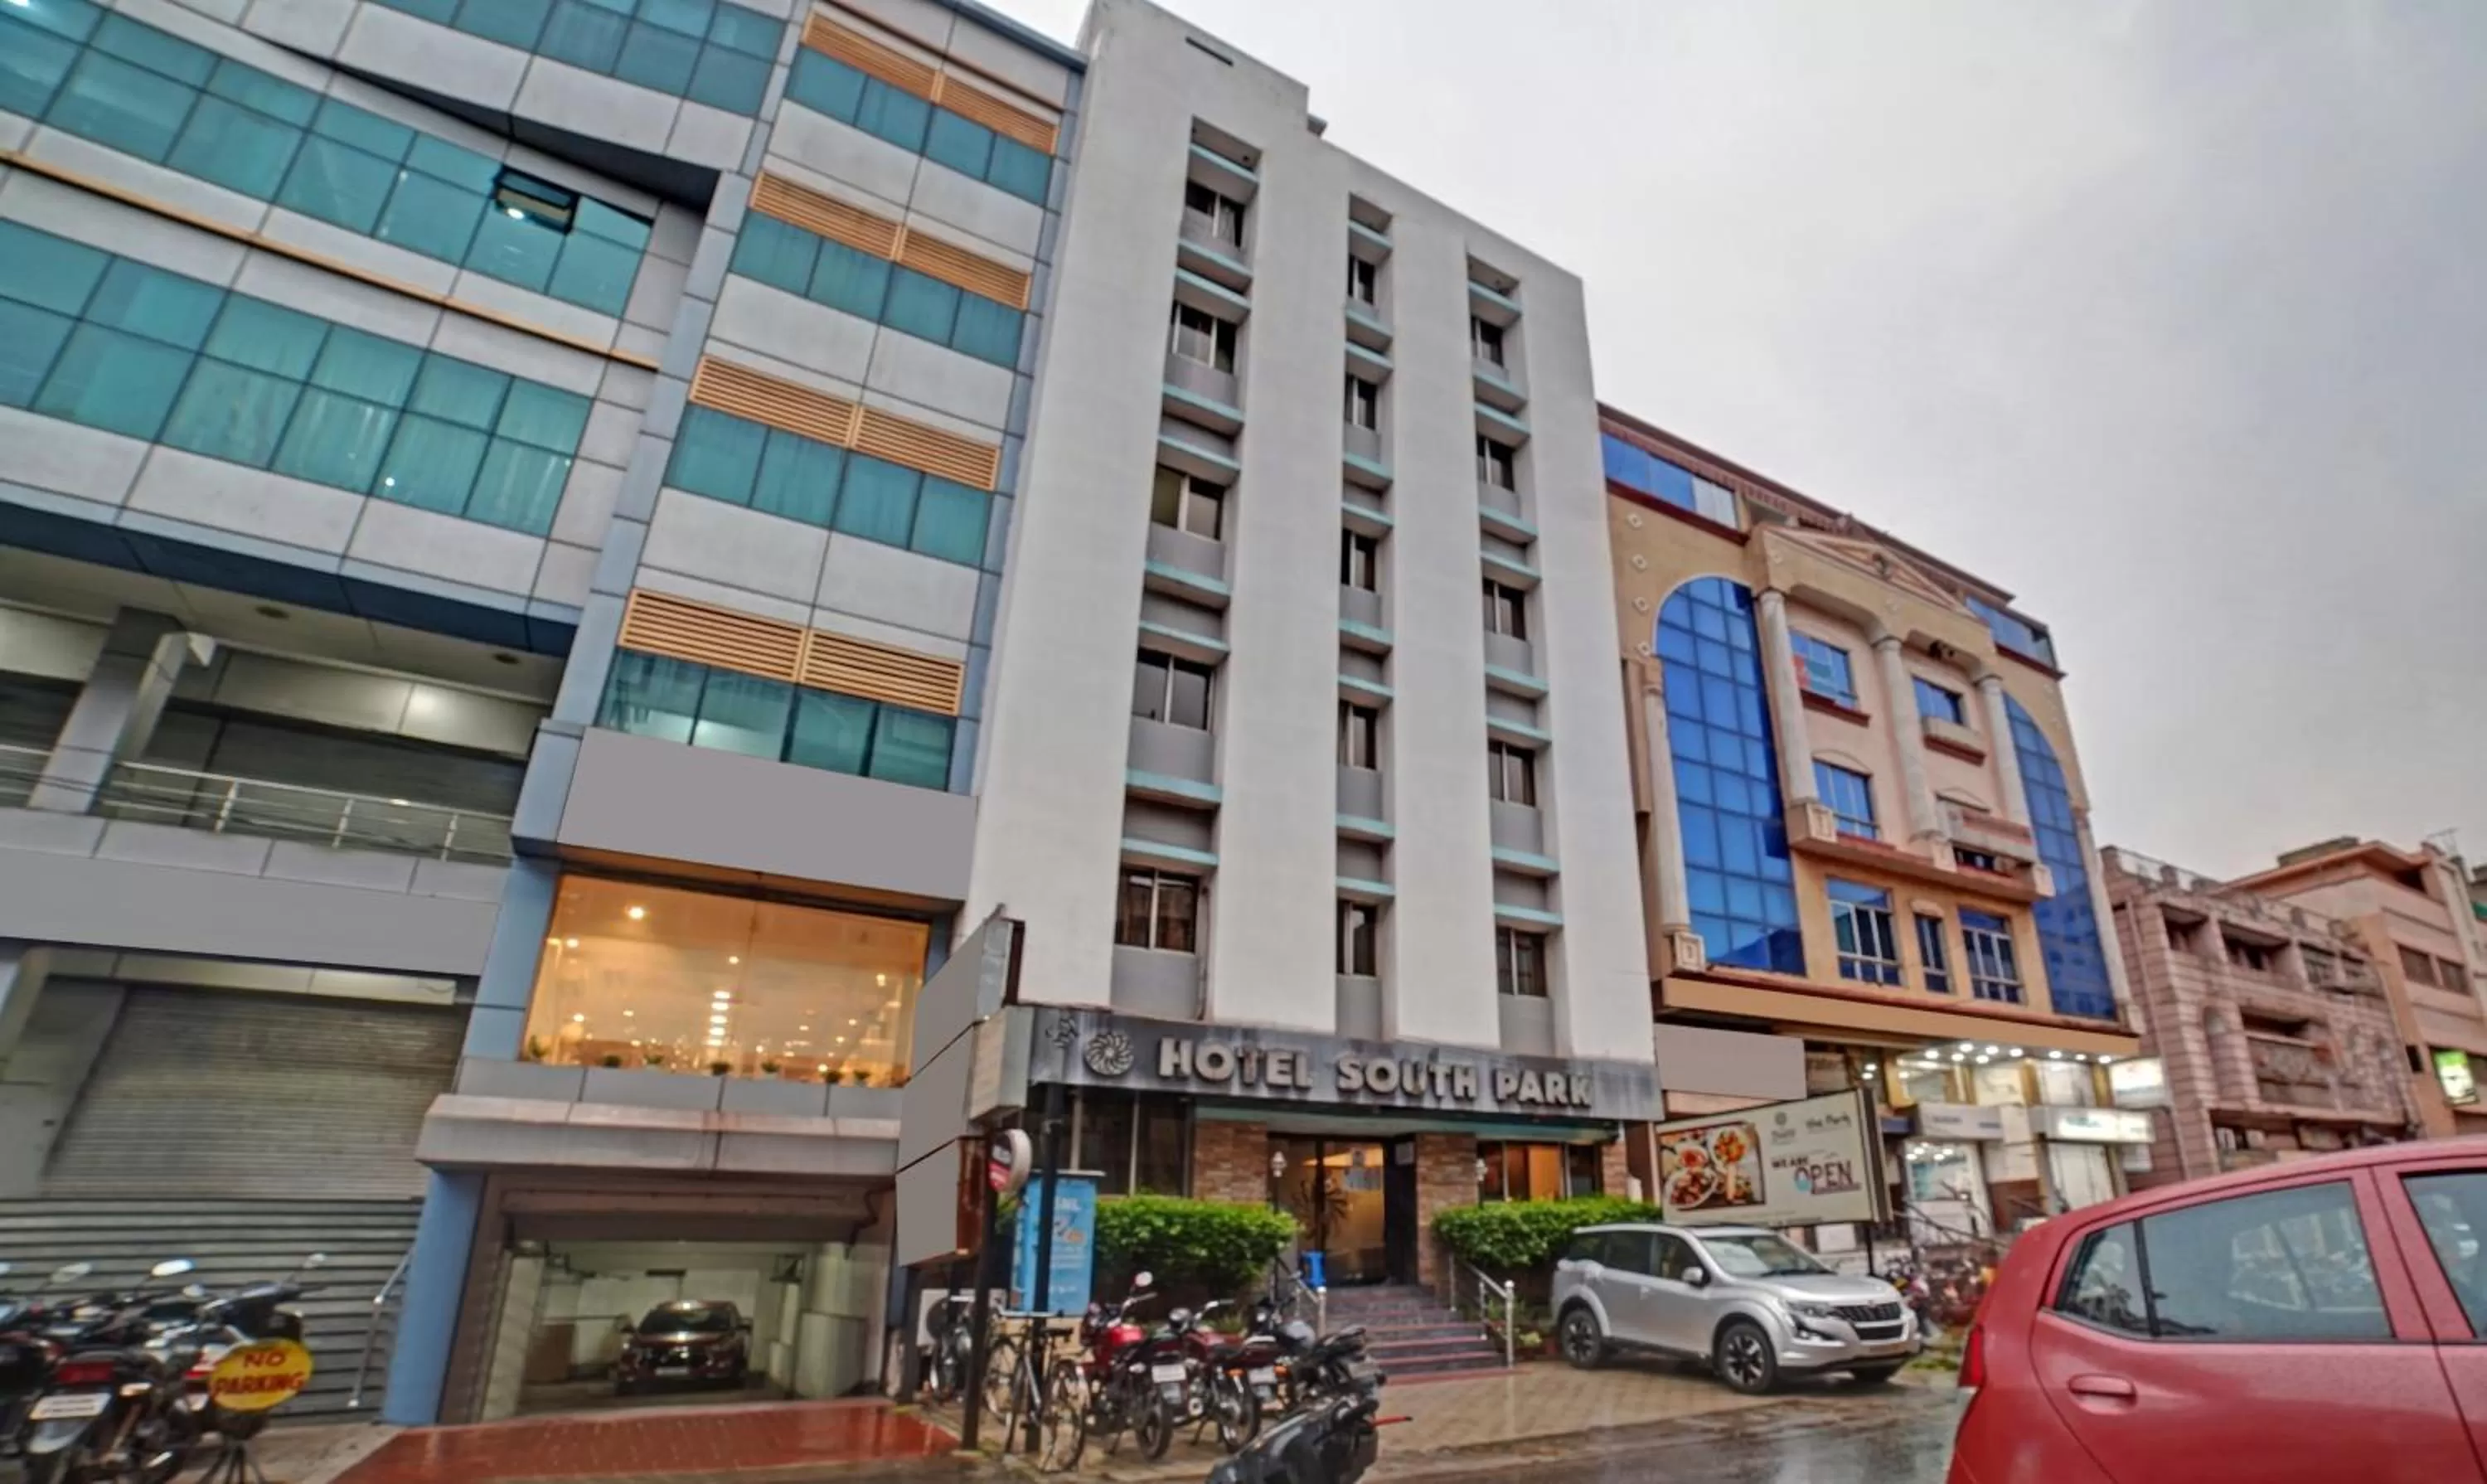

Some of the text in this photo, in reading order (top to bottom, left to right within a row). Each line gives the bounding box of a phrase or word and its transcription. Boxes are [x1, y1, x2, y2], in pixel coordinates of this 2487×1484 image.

[1159, 1037, 1593, 1107] HOTEL SOUTH PARK
[1794, 1160, 1854, 1193] OPEN
[244, 1350, 287, 1368] NO
[213, 1371, 304, 1396] PARKING
